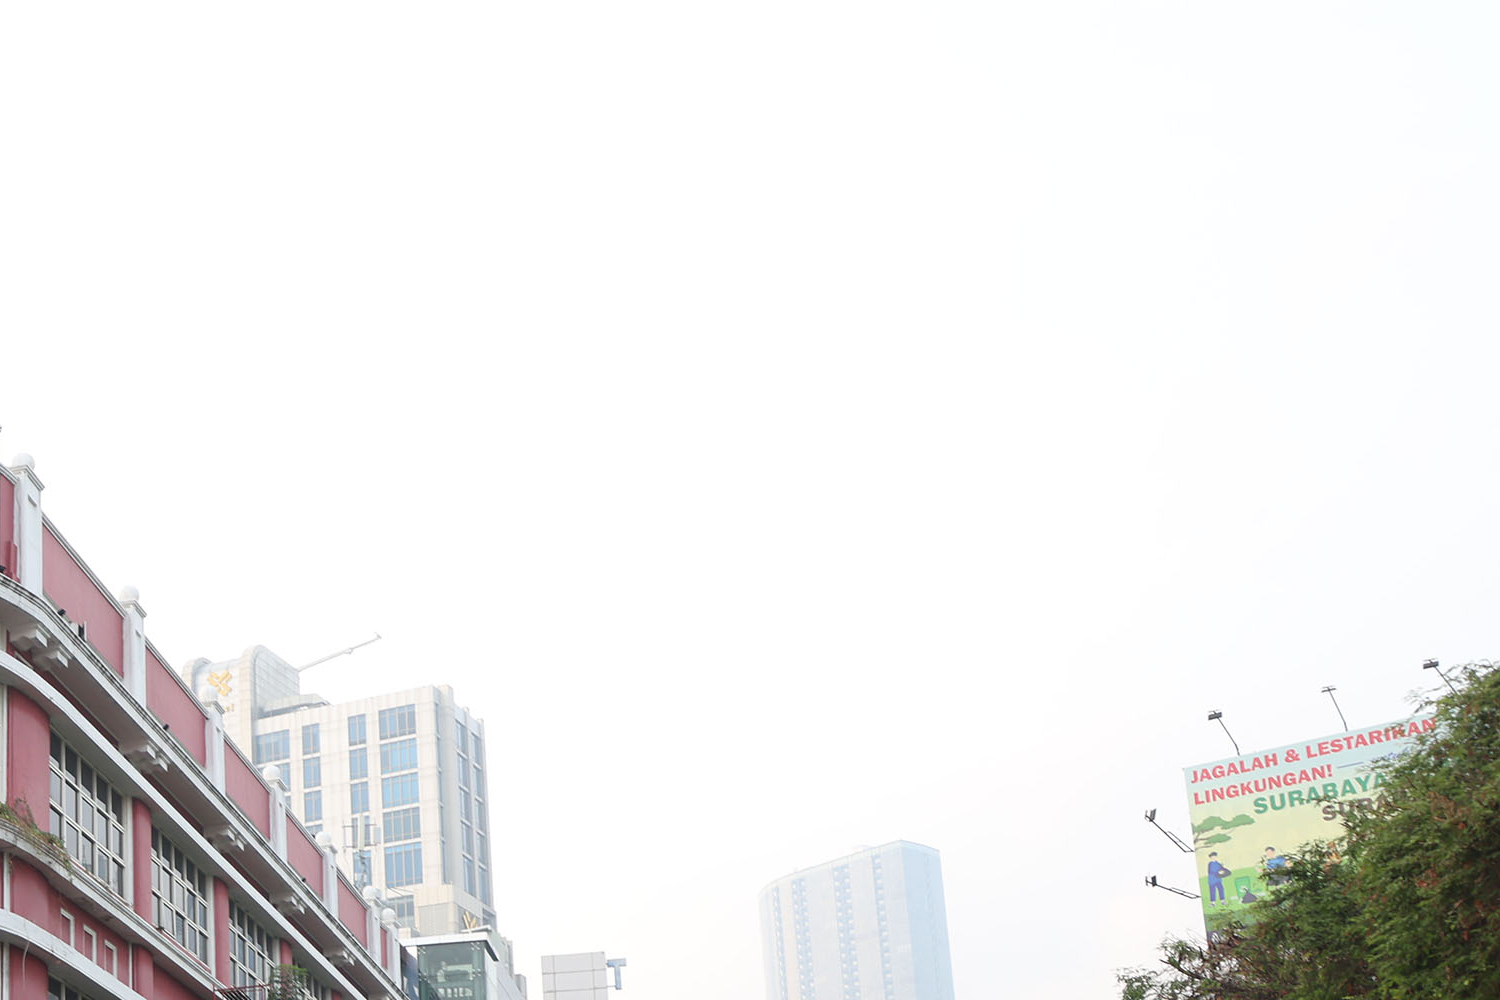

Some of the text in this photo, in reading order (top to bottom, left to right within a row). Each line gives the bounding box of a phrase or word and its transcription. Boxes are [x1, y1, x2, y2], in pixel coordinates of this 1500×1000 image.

[1191, 753, 1278, 784] JAGALAH
[1284, 749, 1301, 763] &
[1305, 717, 1437, 758] LESTARIKAN
[1193, 764, 1333, 805] LINGKUNGAN!
[1253, 772, 1387, 814] SURABAYA
